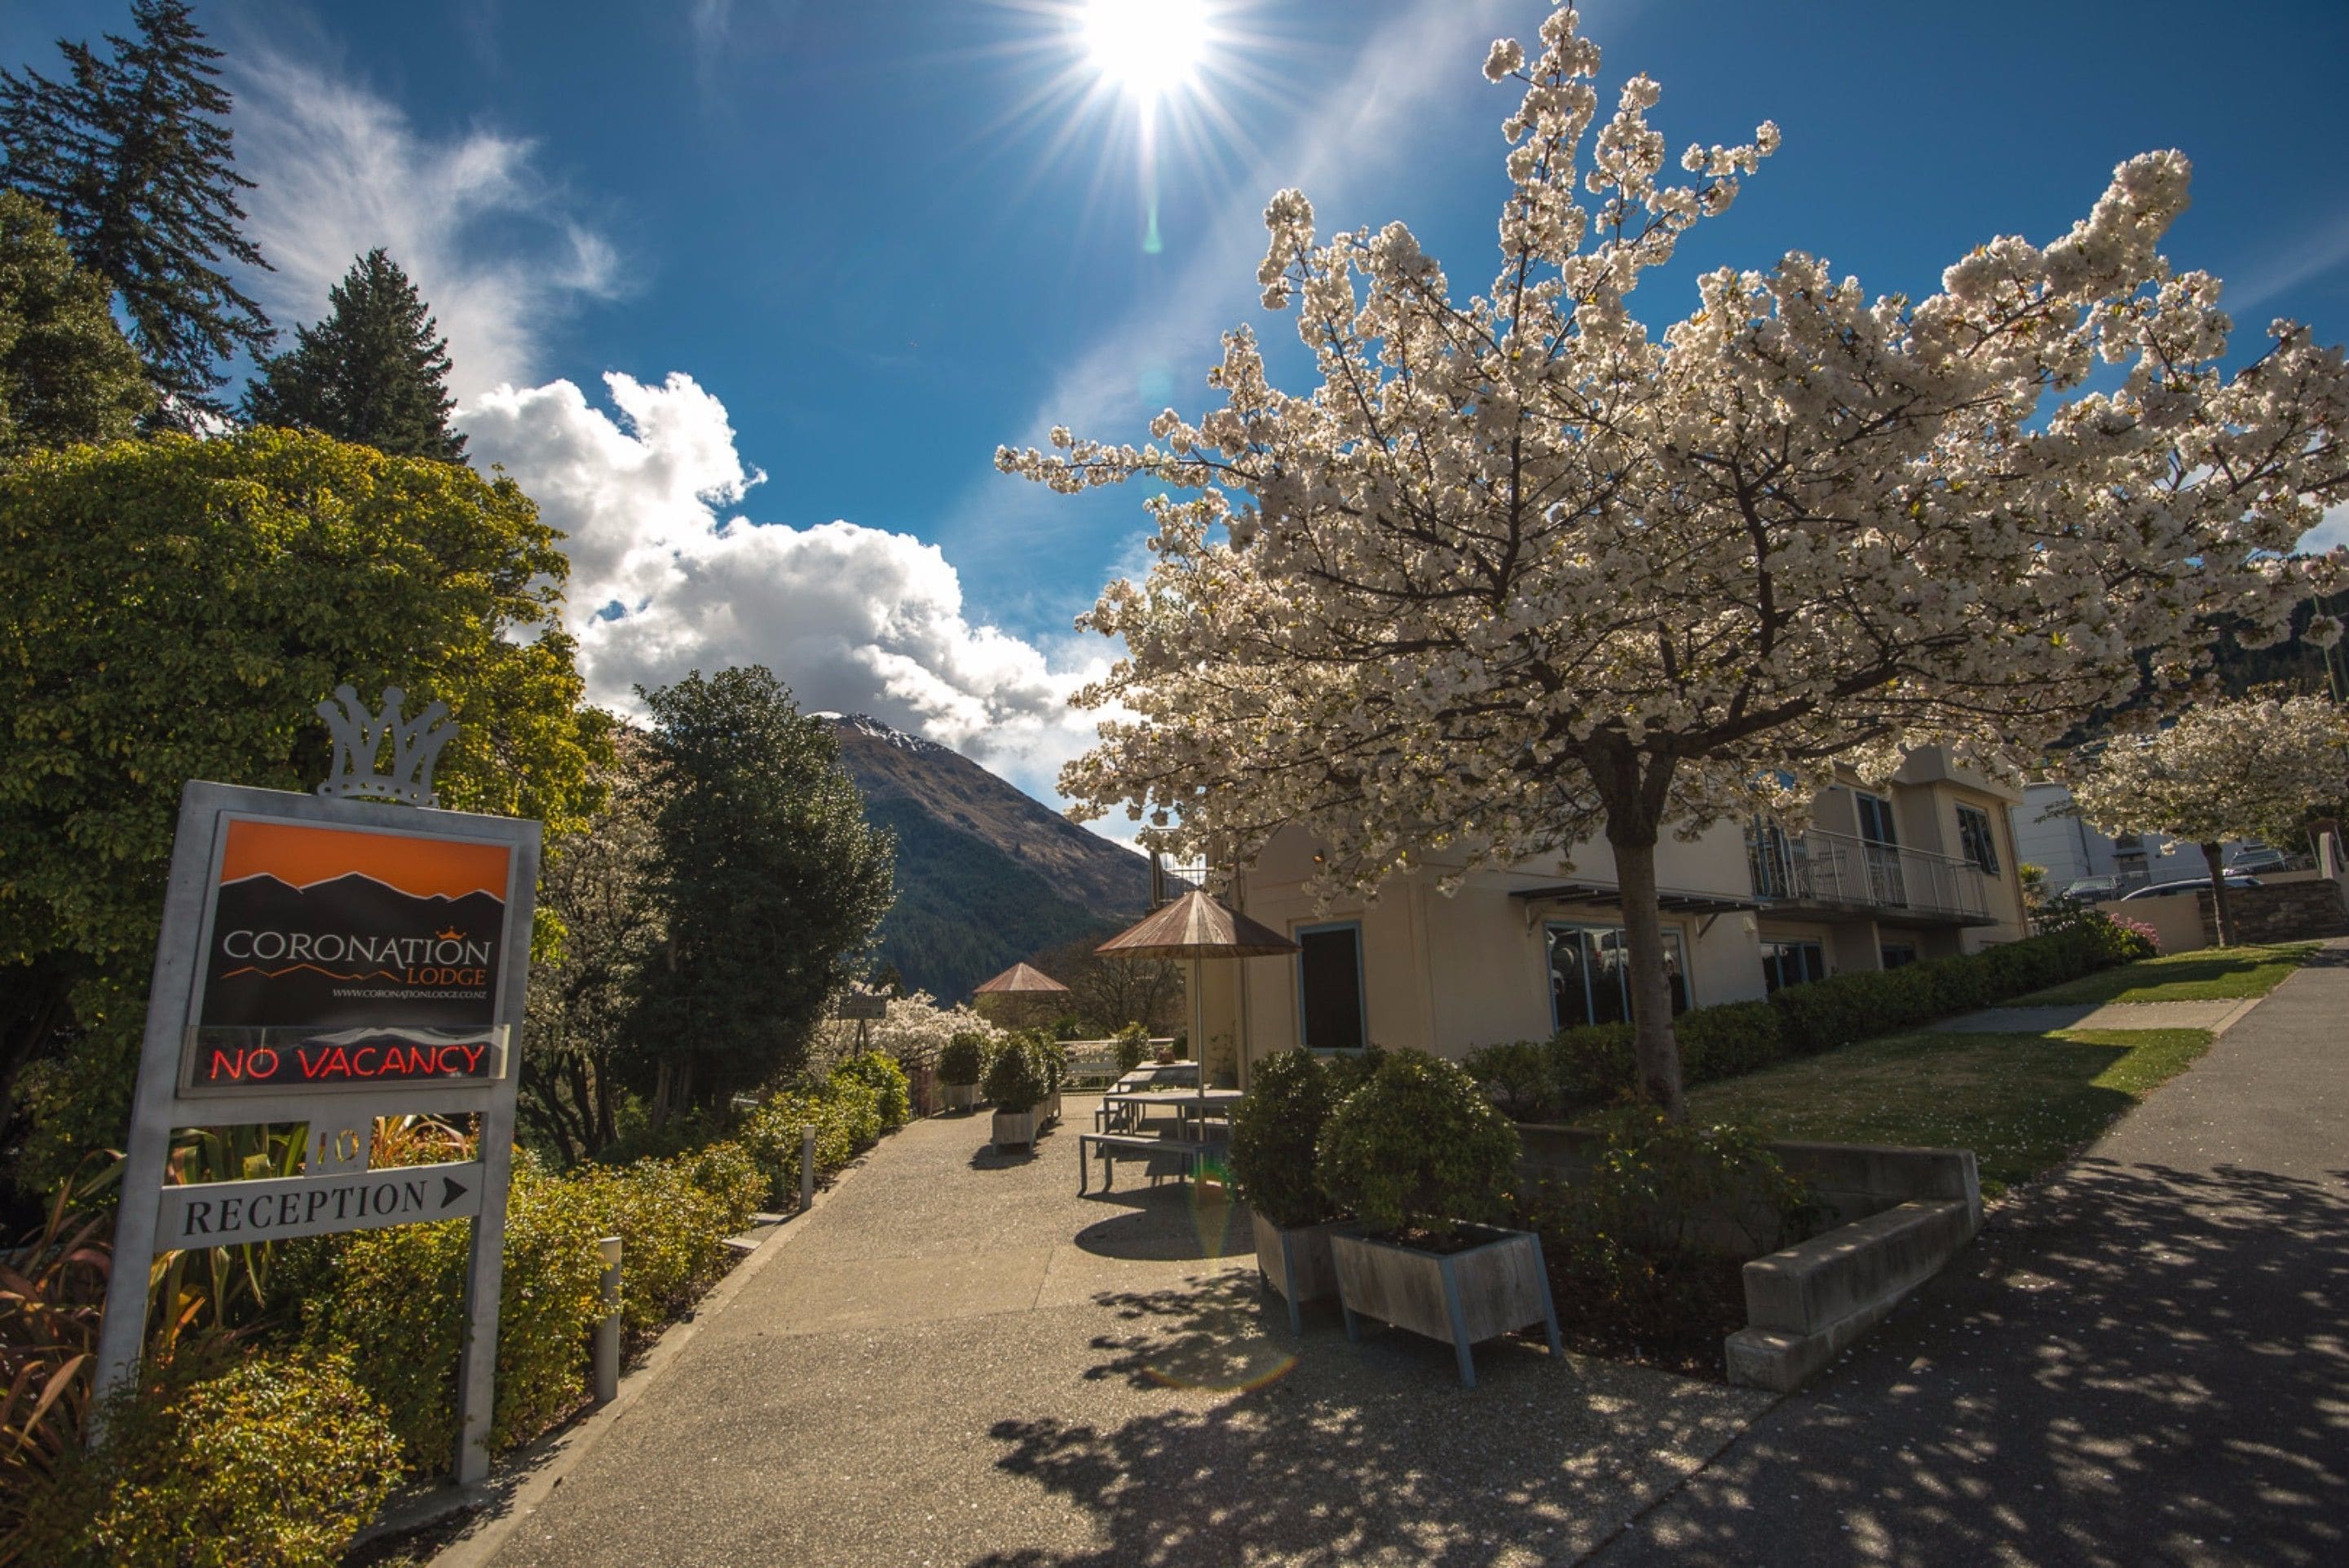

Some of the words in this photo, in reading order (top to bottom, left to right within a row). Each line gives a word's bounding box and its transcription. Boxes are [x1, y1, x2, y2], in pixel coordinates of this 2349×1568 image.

[223, 930, 492, 970] CORONATION
[407, 967, 487, 985] LODGE
[210, 1048, 279, 1080] NO
[296, 1045, 484, 1078] VACANCY
[317, 1129, 360, 1164] 10
[183, 1181, 427, 1236] RECEPTION
